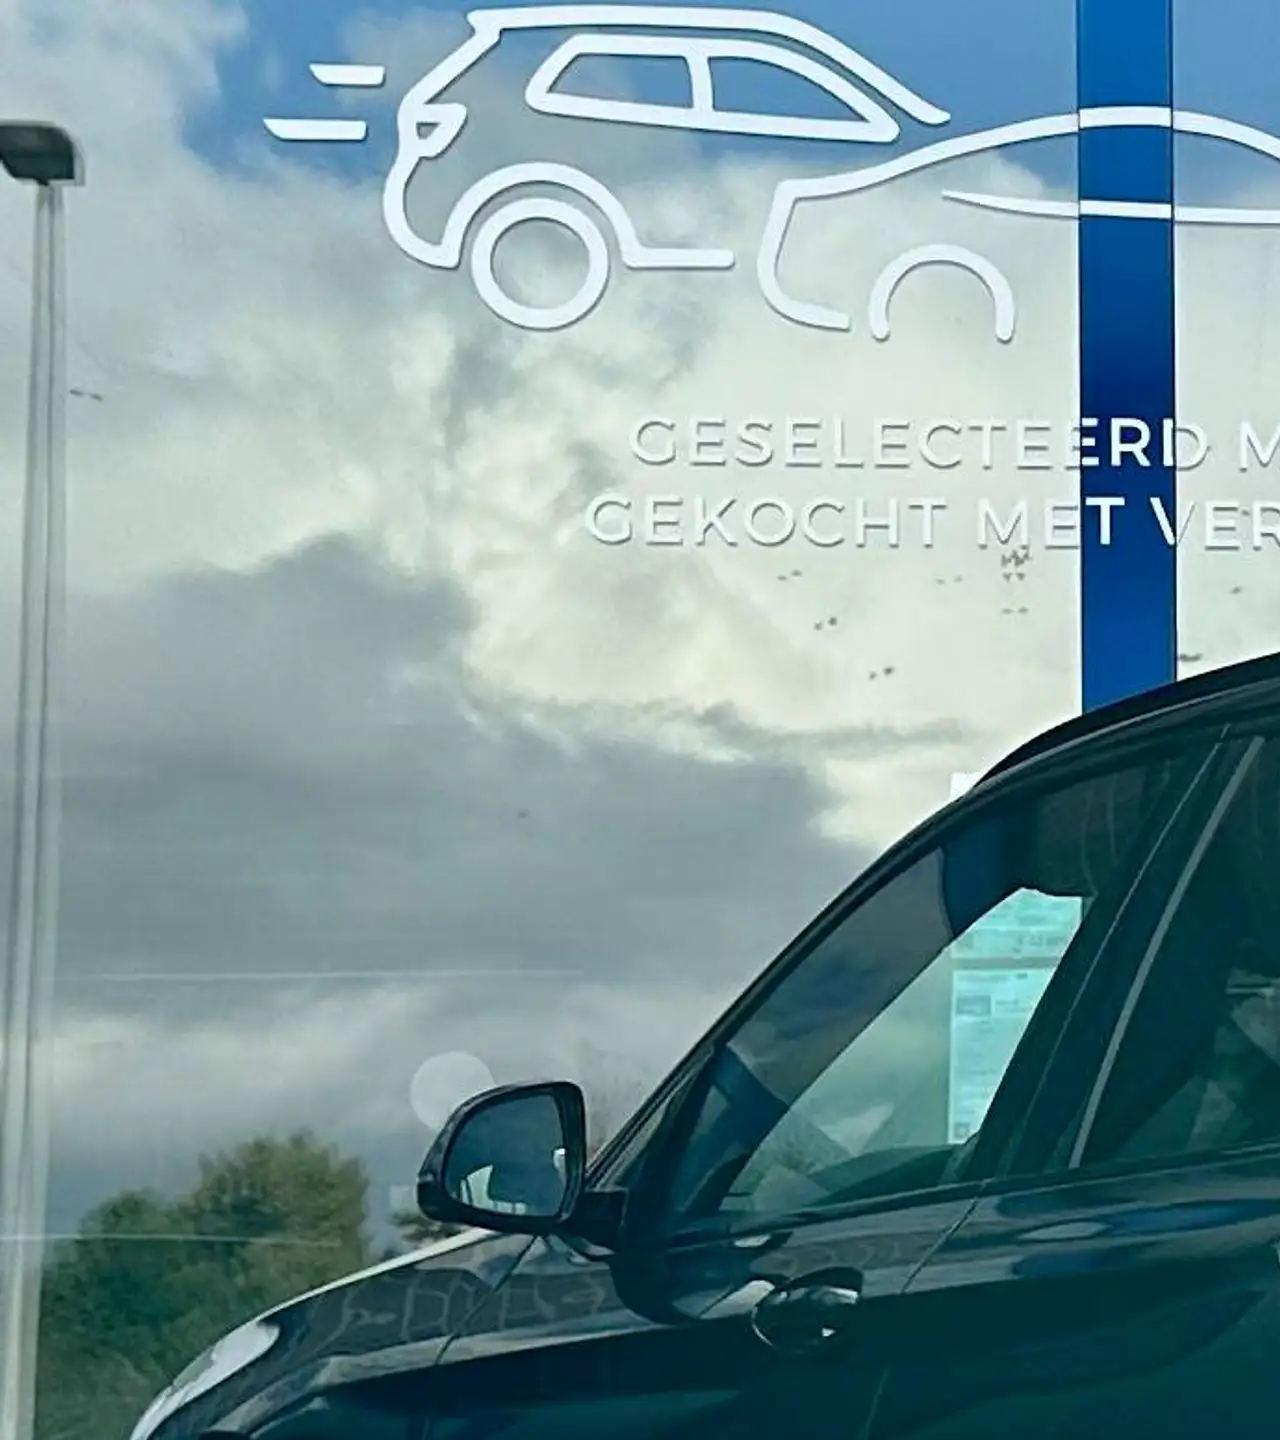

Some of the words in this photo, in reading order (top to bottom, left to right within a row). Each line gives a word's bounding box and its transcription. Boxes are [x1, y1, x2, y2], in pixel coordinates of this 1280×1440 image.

[629, 417, 1211, 471] GESELECTEERD
[584, 493, 948, 548] GEKOCHT
[976, 496, 1127, 549] MET
